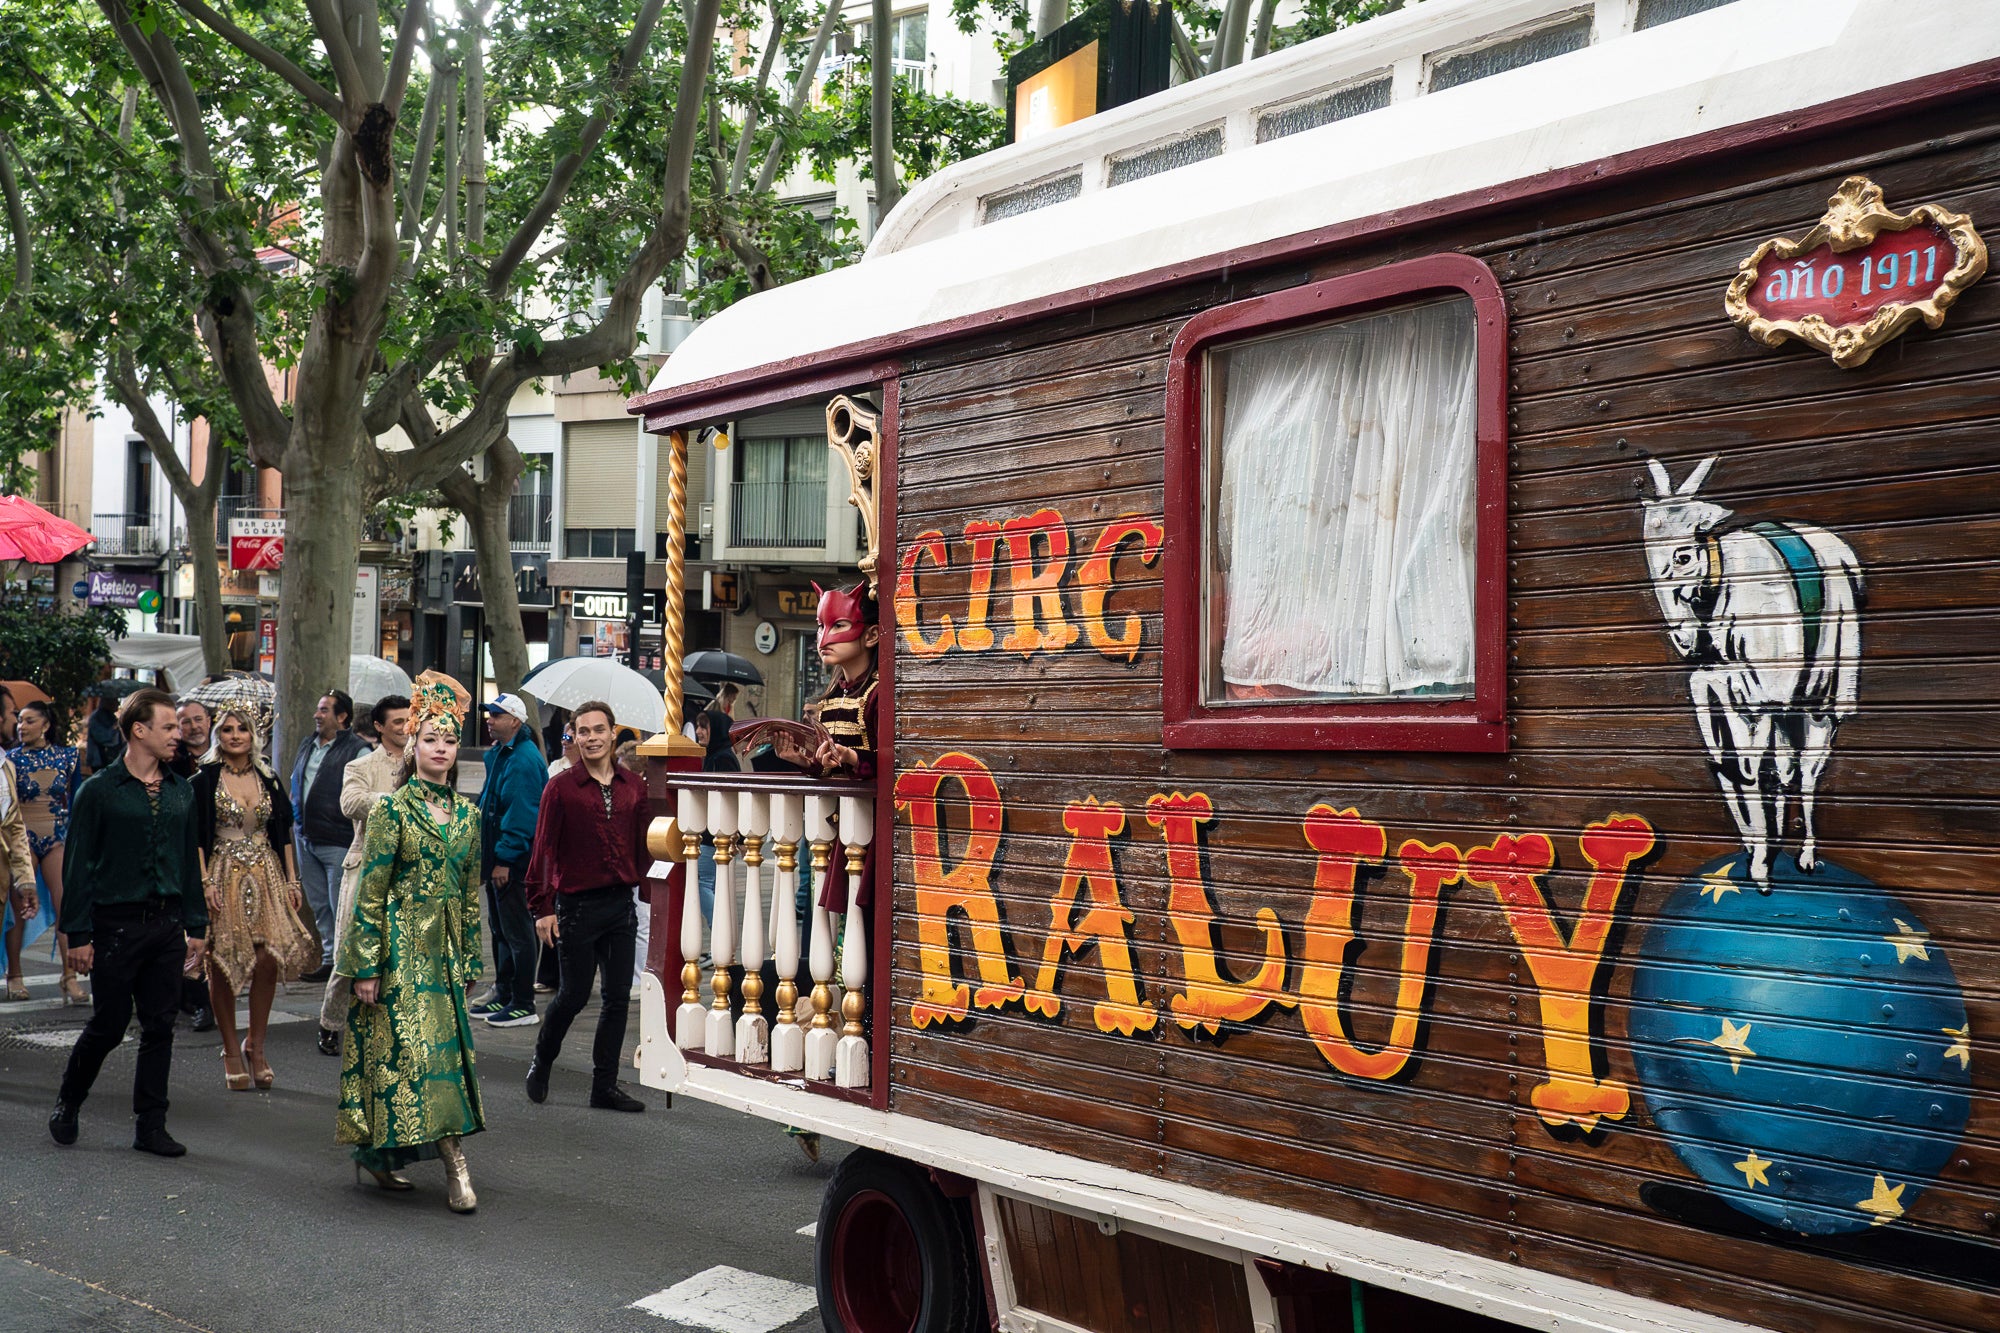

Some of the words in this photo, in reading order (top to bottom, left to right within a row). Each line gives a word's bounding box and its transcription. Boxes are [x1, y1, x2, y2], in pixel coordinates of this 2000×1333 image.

[1765, 258, 1844, 302] año
[1859, 245, 1936, 296] 1911
[91, 575, 137, 596] Asetelco
[893, 508, 1164, 662] CIRC
[894, 751, 1657, 1134] RALUY
